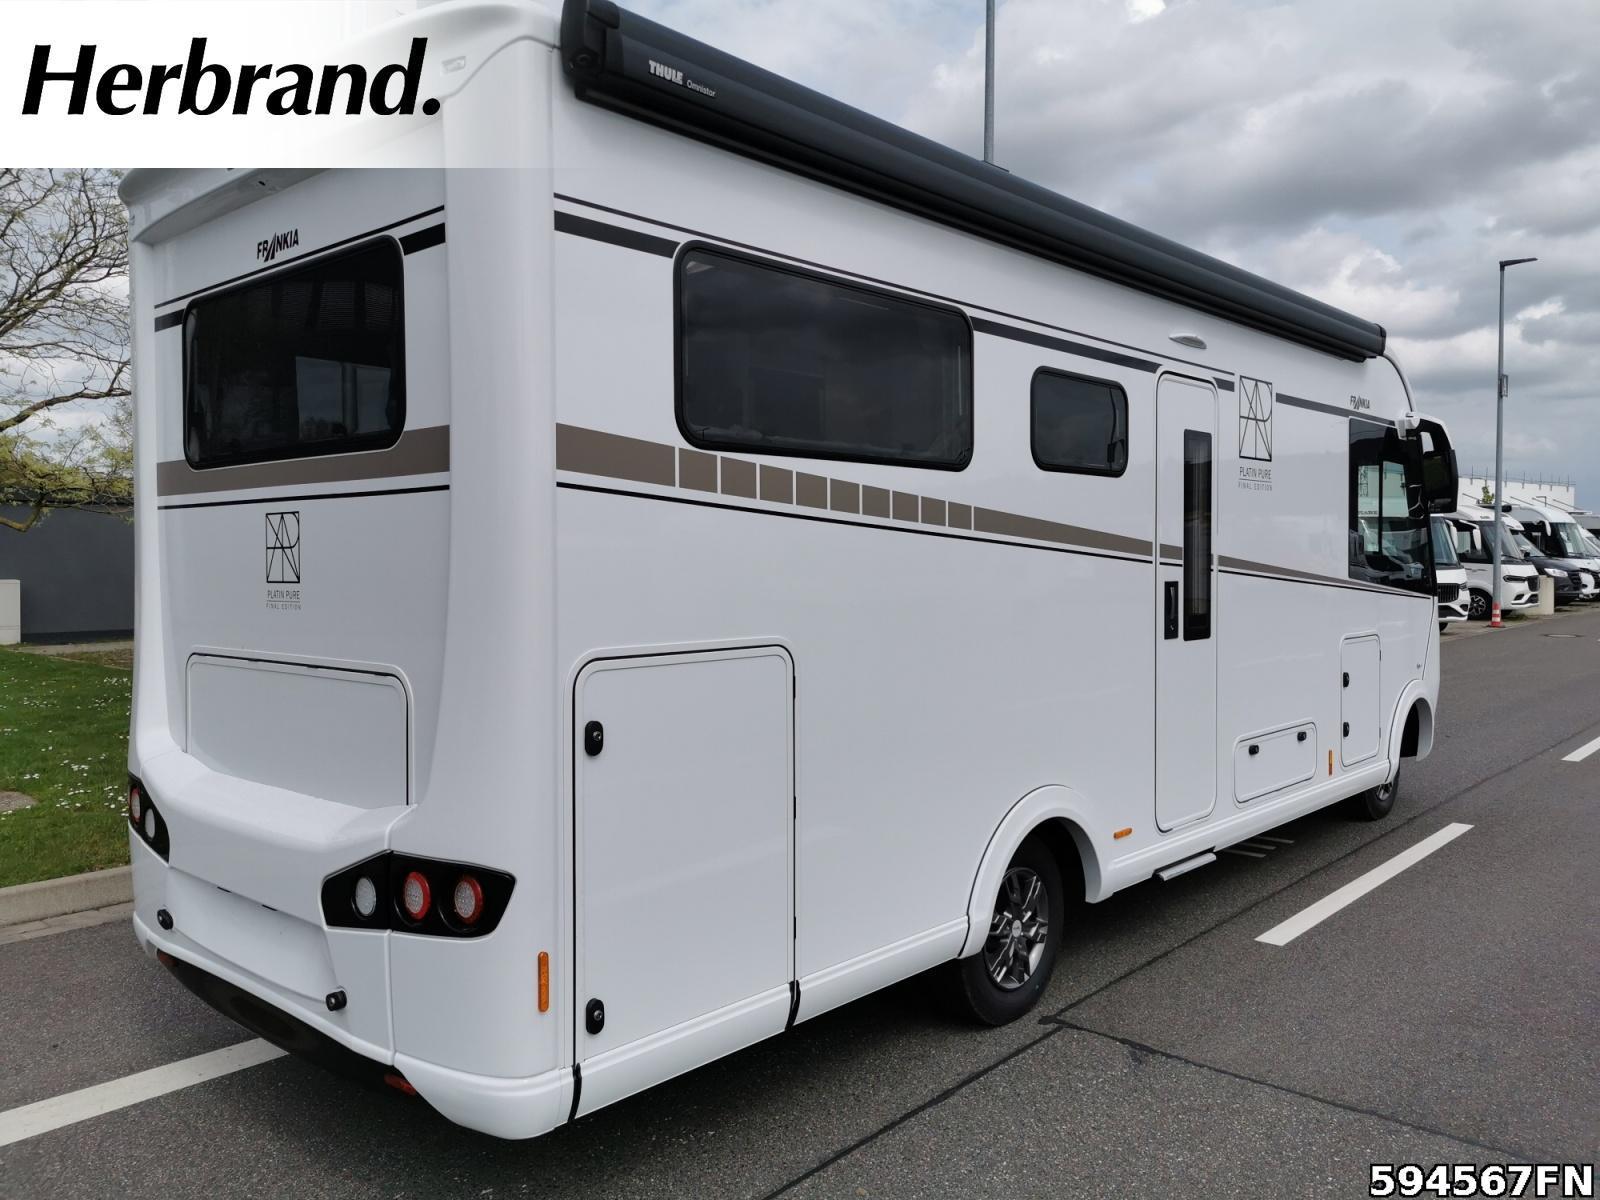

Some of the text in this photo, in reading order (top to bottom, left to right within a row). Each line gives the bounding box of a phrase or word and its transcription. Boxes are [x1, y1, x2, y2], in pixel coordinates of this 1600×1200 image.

[649, 60, 716, 97] THULE Omnistor
[256, 228, 299, 263] FRANKIA
[1239, 466, 1272, 480] PLATIN PURE
[267, 590, 300, 599] PLATIN PURE
